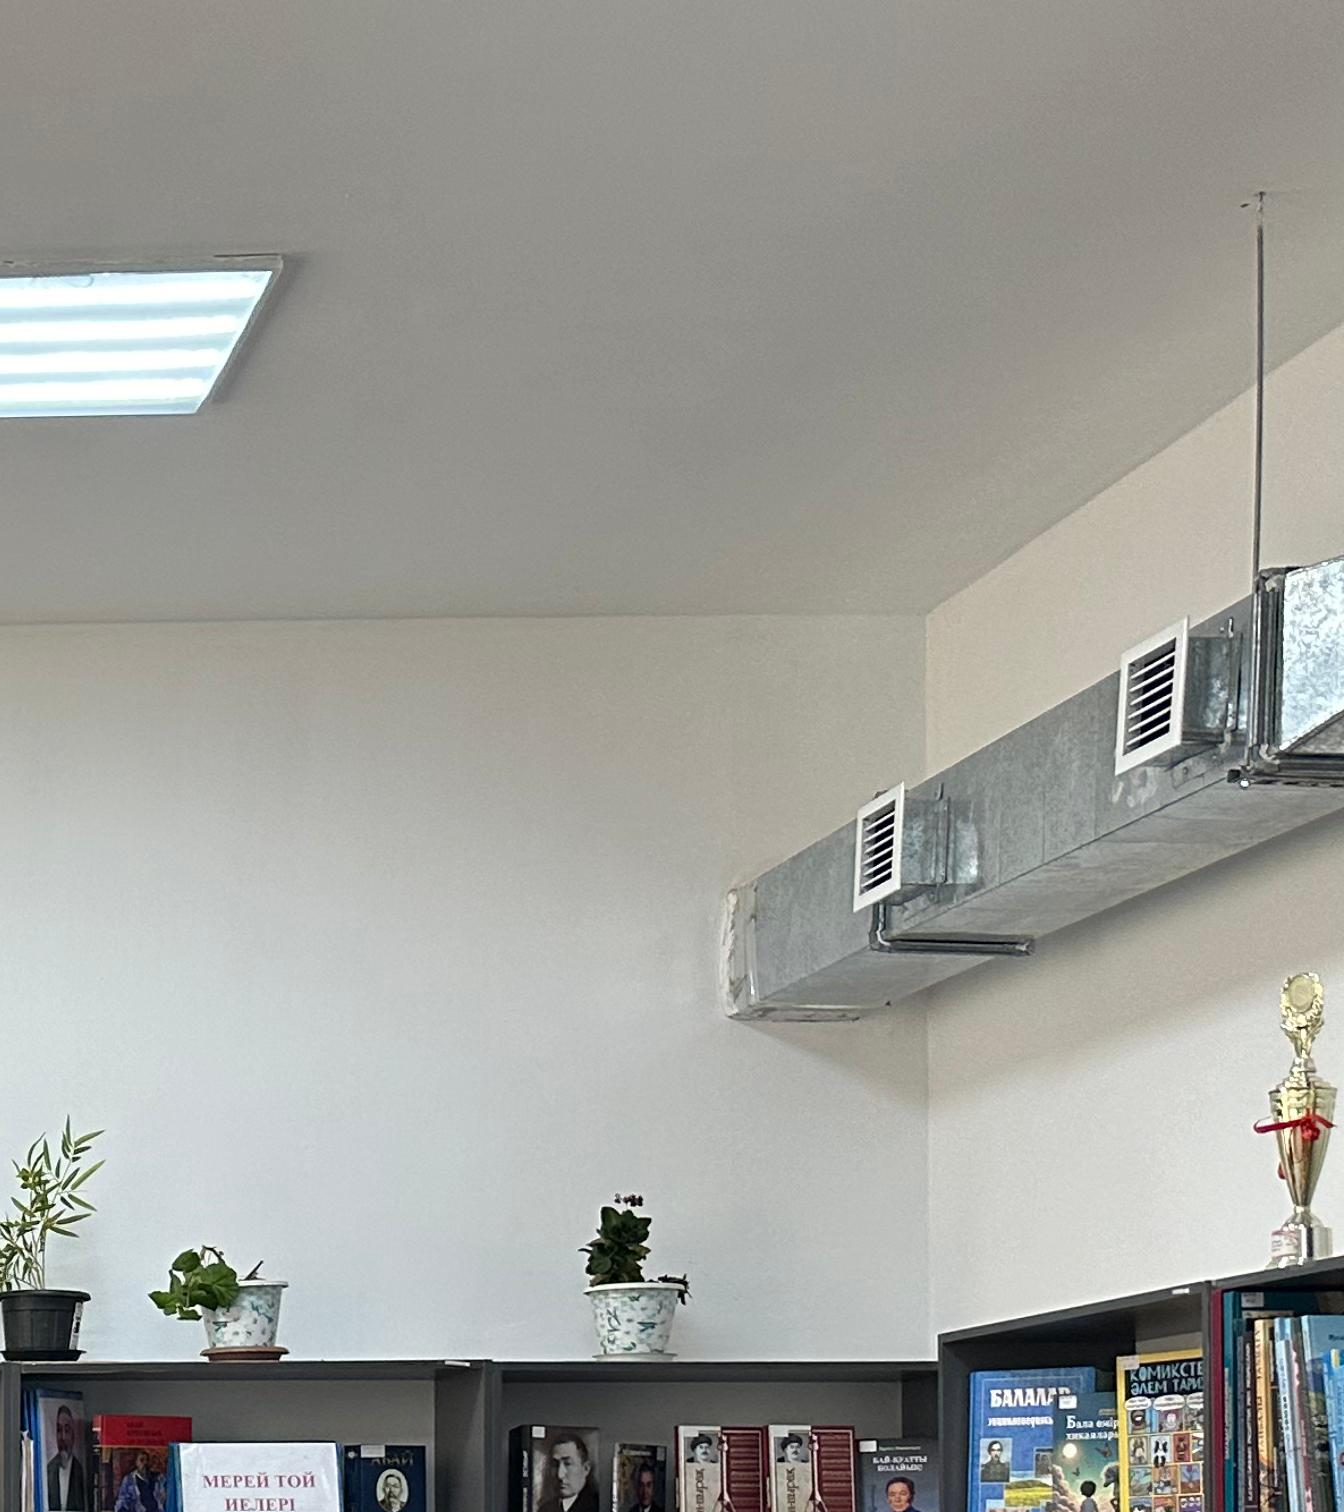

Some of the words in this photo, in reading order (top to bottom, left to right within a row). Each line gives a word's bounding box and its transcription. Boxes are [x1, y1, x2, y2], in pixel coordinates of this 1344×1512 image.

[1130, 1364, 1204, 1382] КОМИКСТЕ
[1130, 1379, 1168, 1394] ӘЛЕМ
[1066, 1415, 1094, 1429] Бала
[203, 1471, 269, 1489] МЕРЕЙ
[274, 1471, 316, 1488] ТОЙ
[225, 1498, 295, 1512] ИЕЛЕРІ
